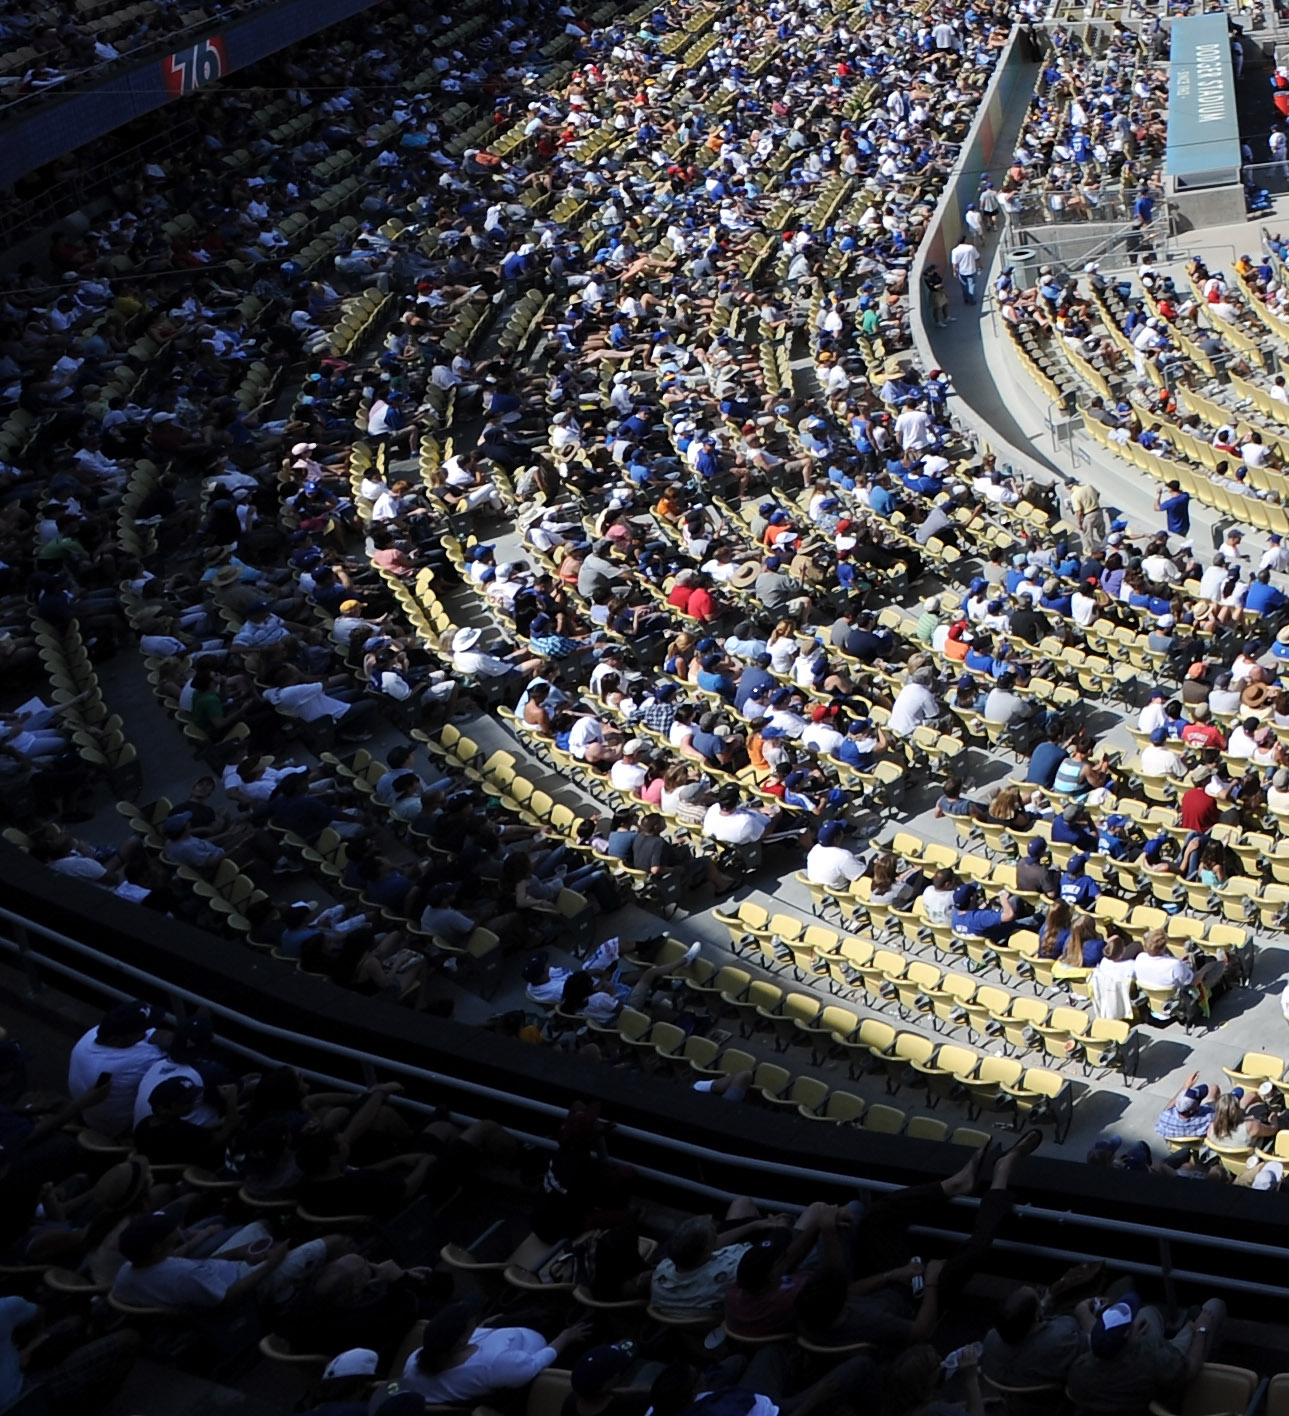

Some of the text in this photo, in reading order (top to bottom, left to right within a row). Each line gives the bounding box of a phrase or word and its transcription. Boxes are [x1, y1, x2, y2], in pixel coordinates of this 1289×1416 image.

[170, 37, 222, 97] 76
[1195, 43, 1225, 123] DODGER STADIUM
